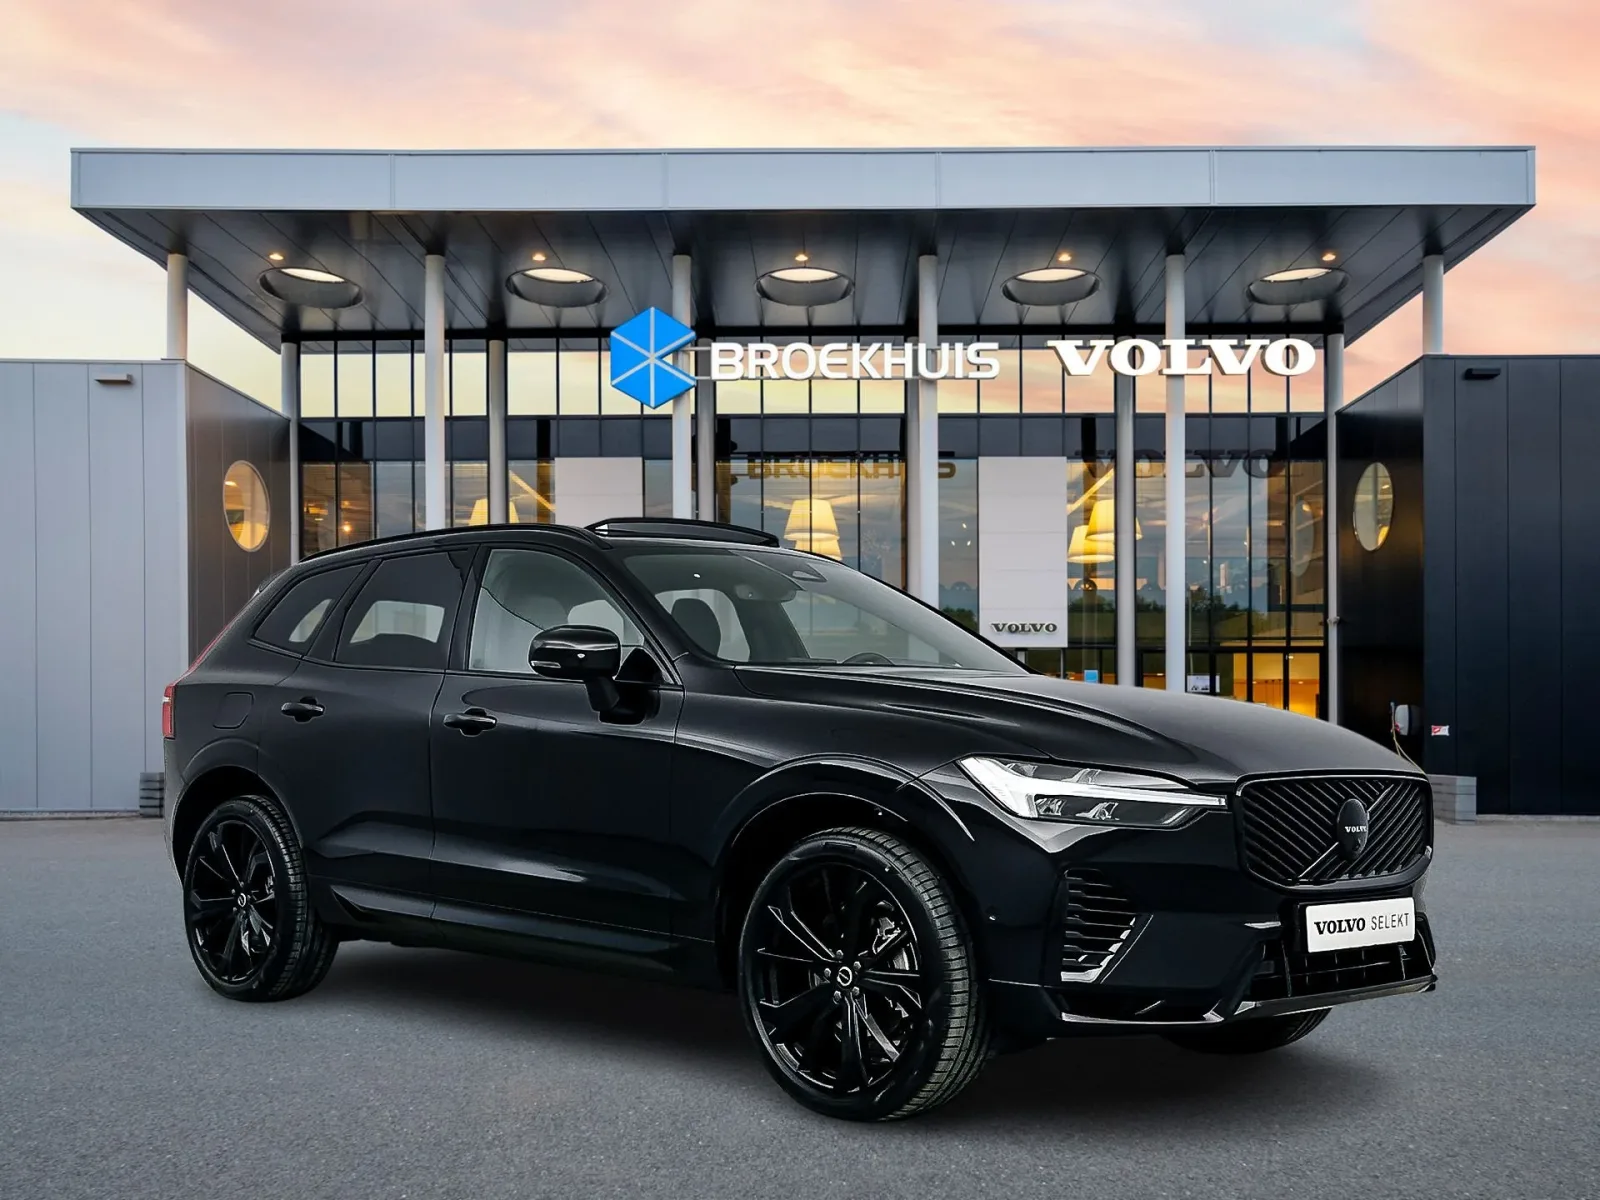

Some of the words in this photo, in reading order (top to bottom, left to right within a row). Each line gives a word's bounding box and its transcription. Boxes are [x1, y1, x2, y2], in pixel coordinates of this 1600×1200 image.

[710, 342, 1000, 380] BROEKHUIS
[1046, 338, 1316, 376] VOLVO
[990, 622, 1058, 634] VOLVO
[1314, 917, 1366, 935] VOLVO
[1371, 912, 1409, 931] SELEKT
